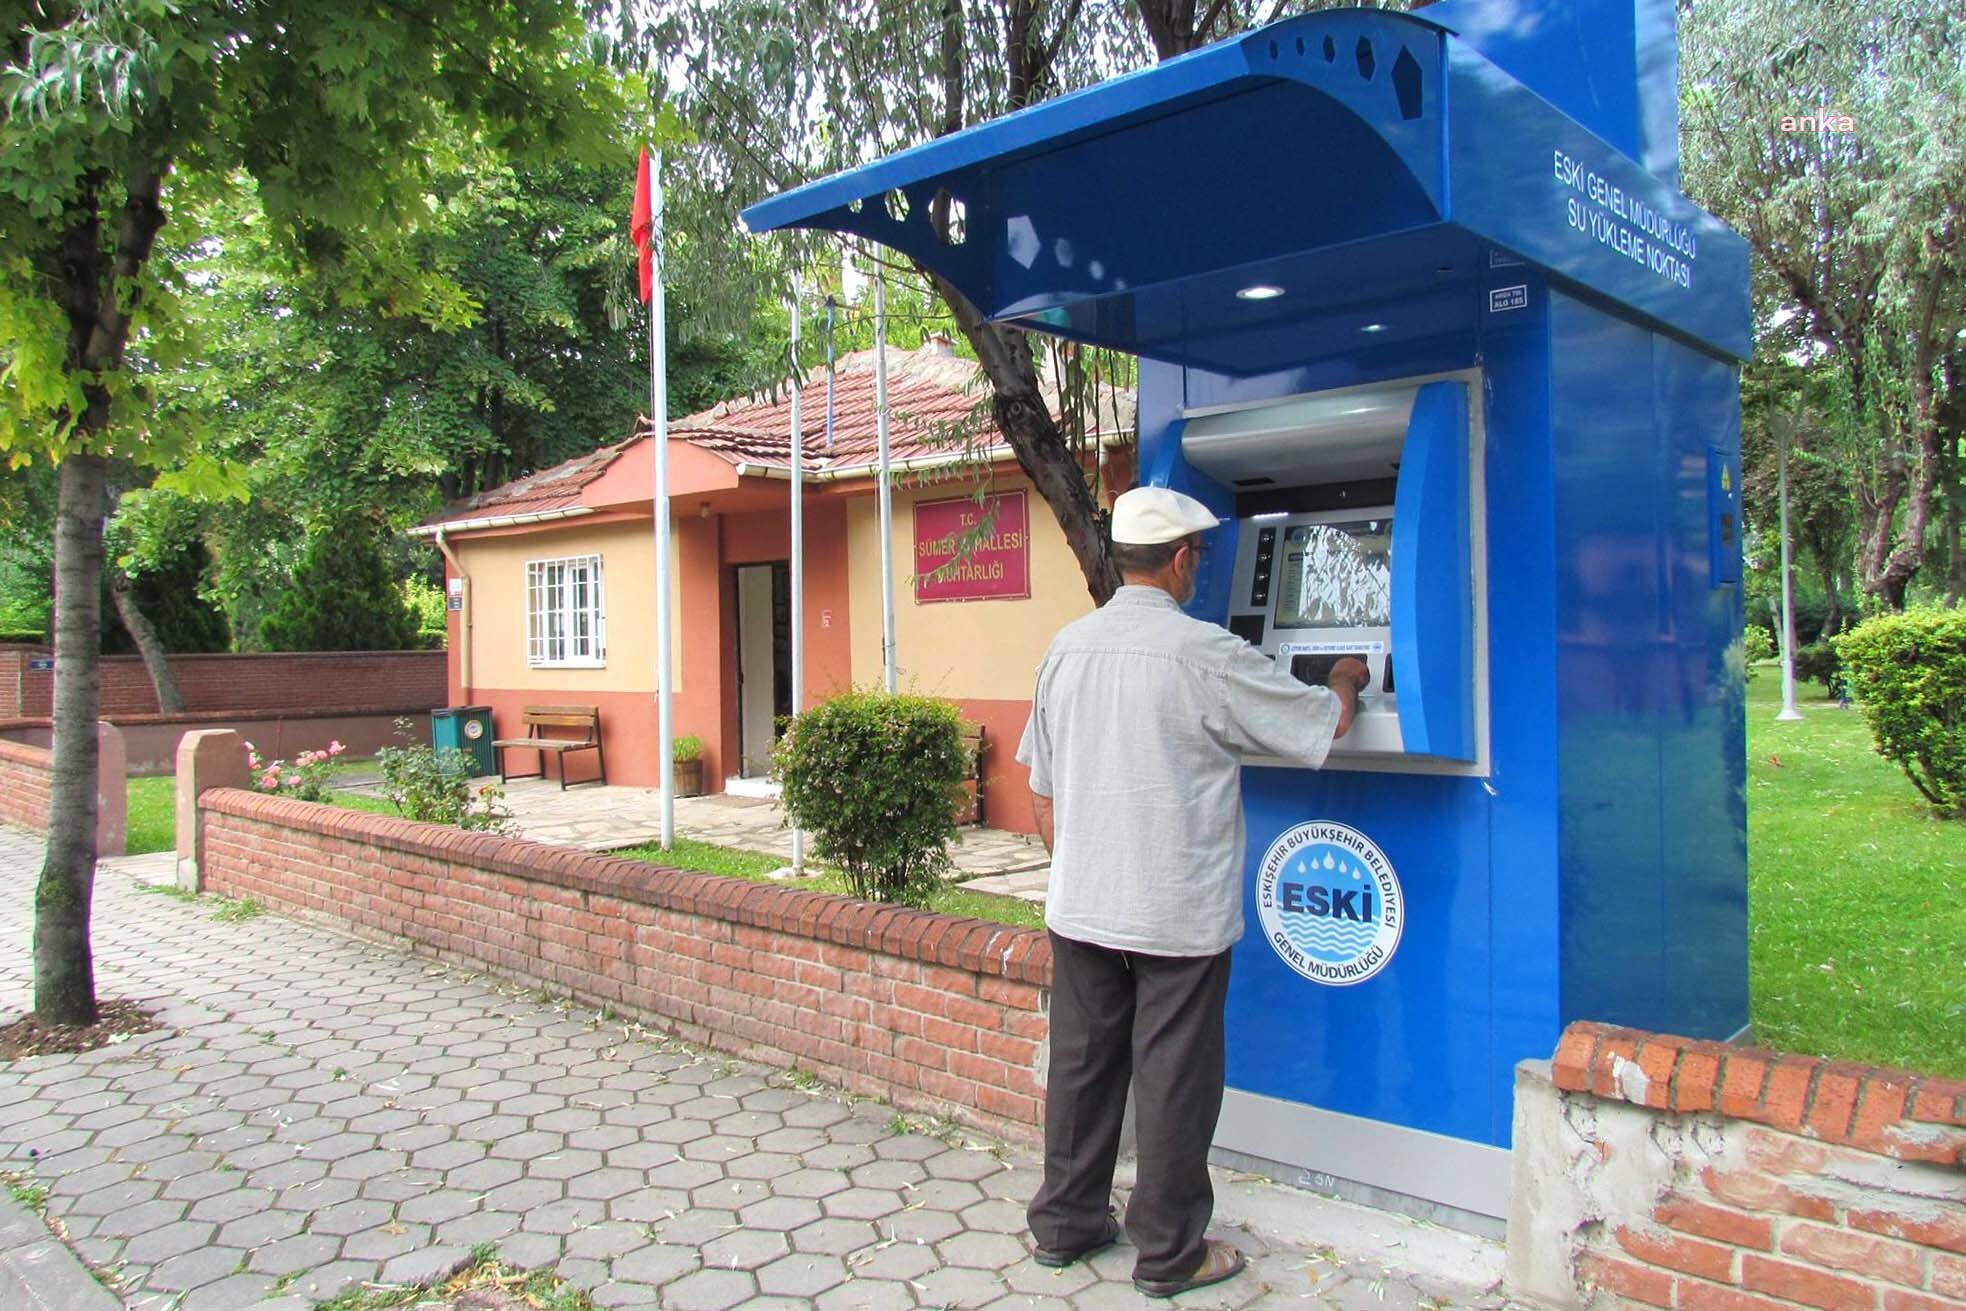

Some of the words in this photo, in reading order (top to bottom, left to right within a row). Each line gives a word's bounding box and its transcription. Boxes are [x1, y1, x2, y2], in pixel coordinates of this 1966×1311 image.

[1554, 150, 1584, 193] ESKİ
[1587, 173, 1628, 220] GENEL
[1567, 198, 1587, 232] SU
[1588, 209, 1645, 265] YÜKLEME
[1646, 244, 1691, 289] NOKTASI
[919, 538, 956, 557] SÜMER
[959, 529, 1023, 554] HALLESİ
[1283, 883, 1373, 923] ESKİ
[1274, 931, 1306, 969] GENEL
[1308, 943, 1385, 979] MÜDÜRLÜĞÜ
